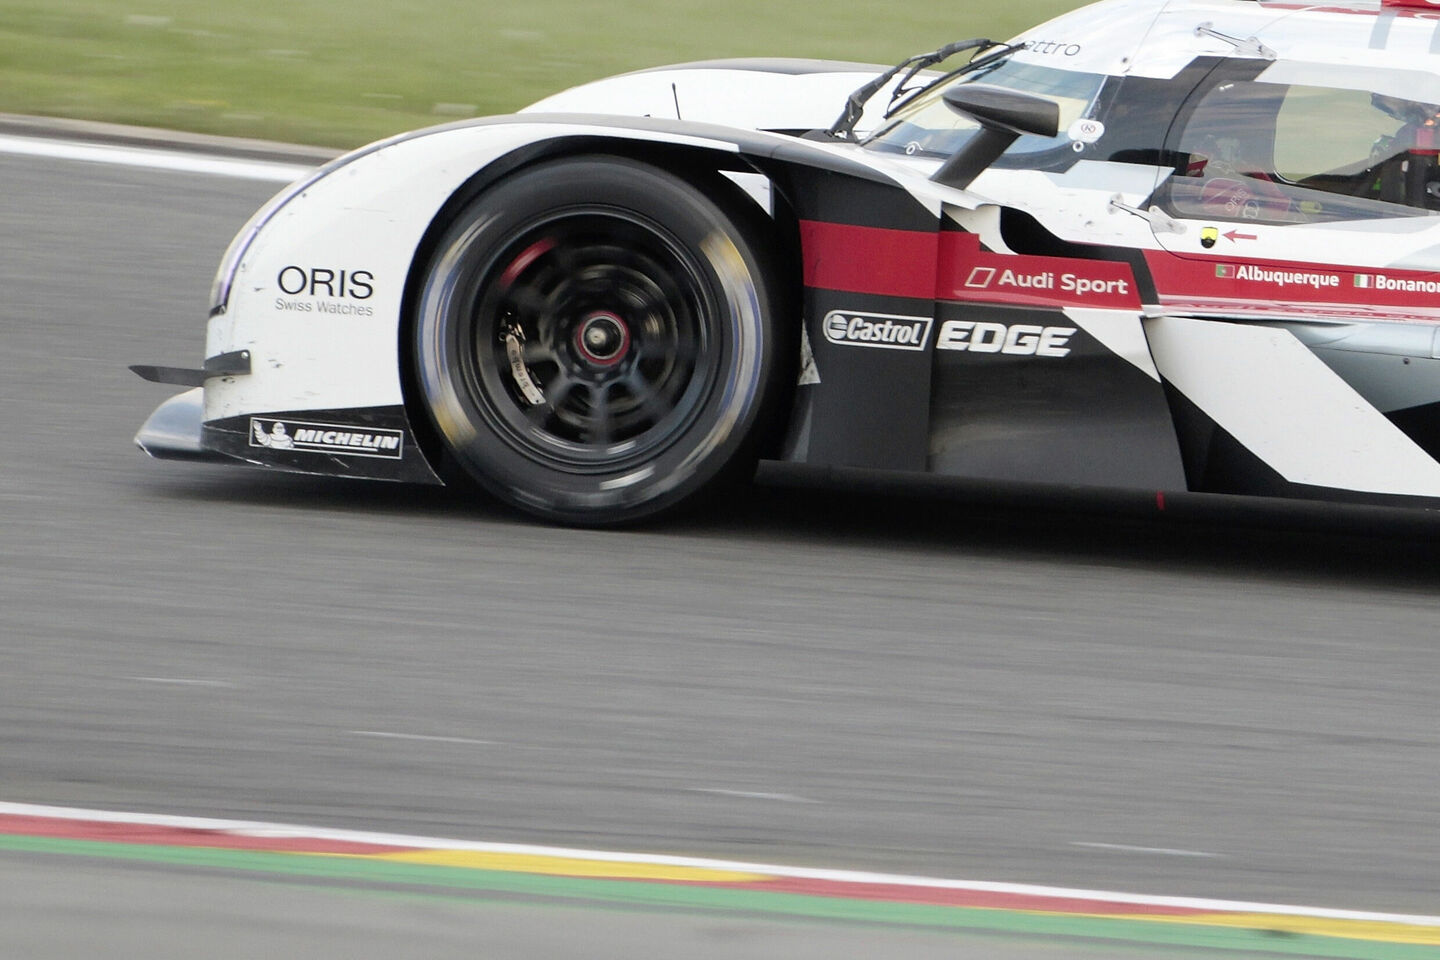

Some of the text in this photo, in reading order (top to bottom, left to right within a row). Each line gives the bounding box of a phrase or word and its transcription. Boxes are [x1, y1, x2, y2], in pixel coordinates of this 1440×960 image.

[277, 265, 374, 300] ORIS
[997, 269, 1129, 295] Audi Sport
[1236, 265, 1340, 289] Albuquerque
[275, 297, 374, 317] Swiss Watches
[846, 316, 1078, 358] Castrol EDGE
[293, 428, 400, 450] MICHELIN
